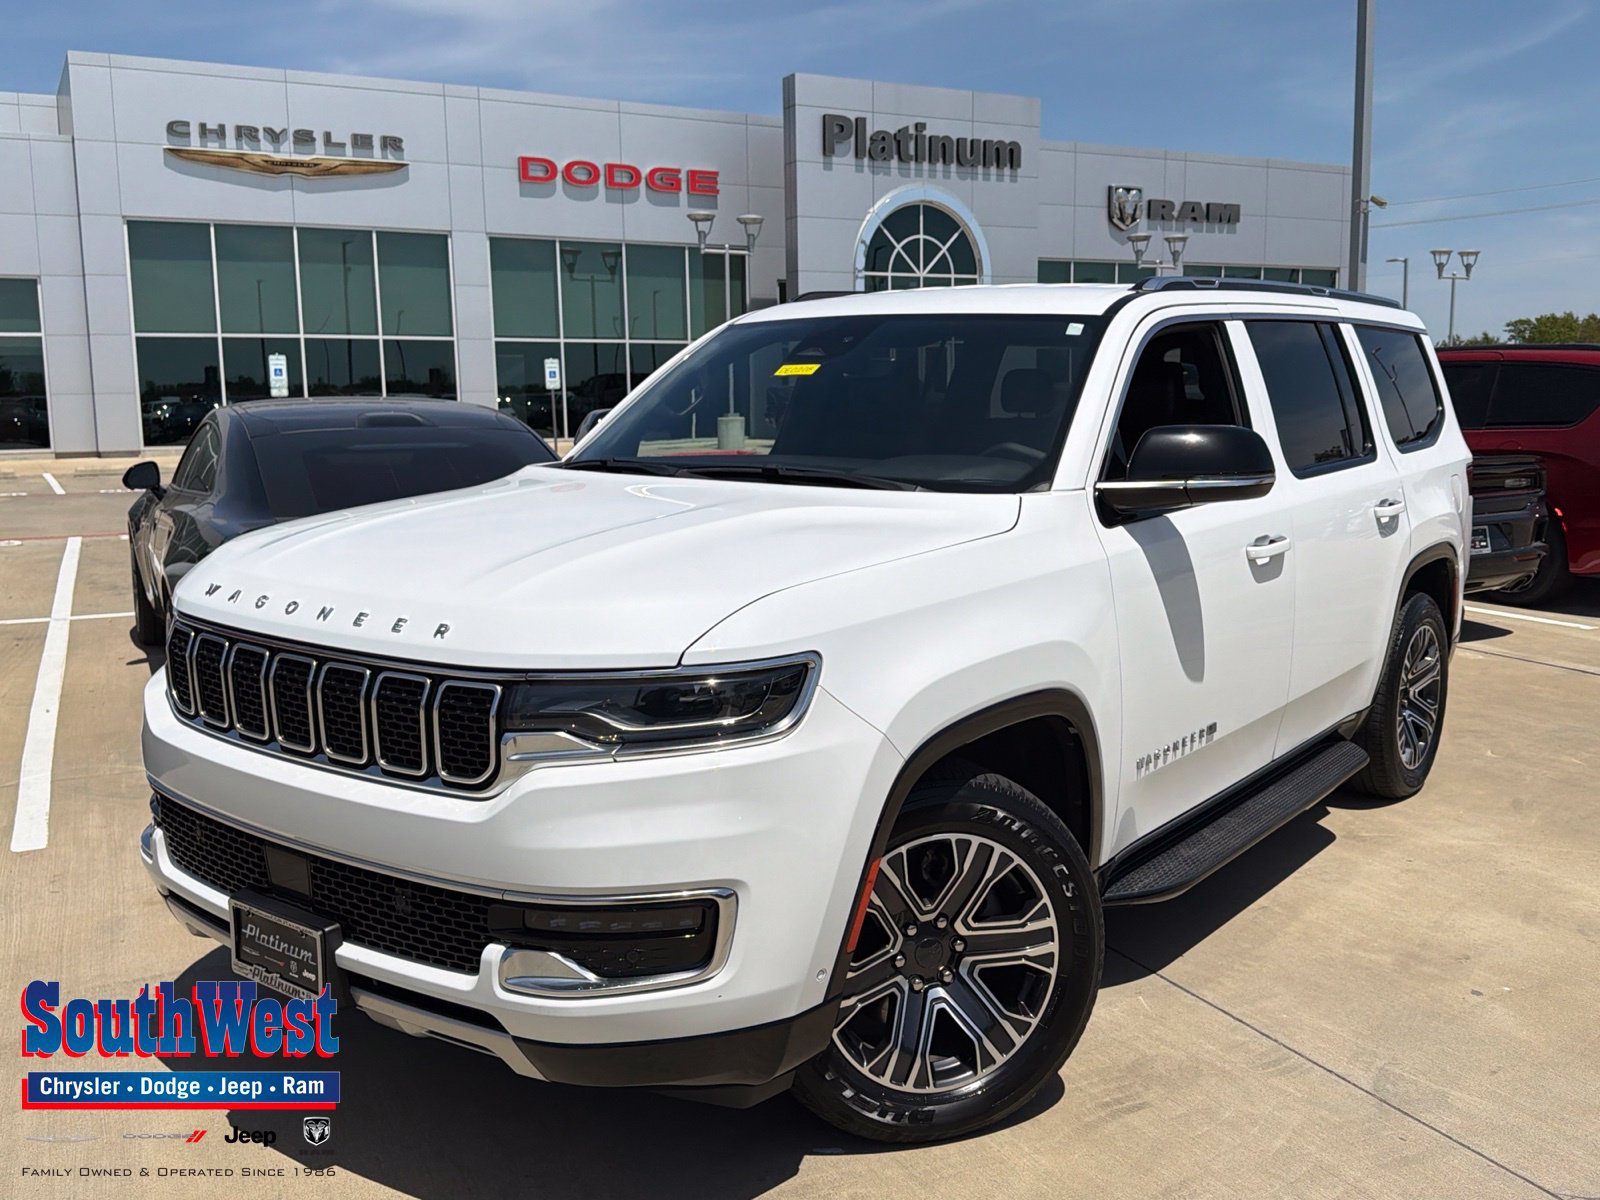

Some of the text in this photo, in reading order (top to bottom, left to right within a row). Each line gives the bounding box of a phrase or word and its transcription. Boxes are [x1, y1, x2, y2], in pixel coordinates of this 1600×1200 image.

[166, 119, 404, 151] CHRYSLER
[822, 113, 1022, 170] Platinum
[518, 156, 720, 195] DODGE
[1147, 199, 1241, 224] RAM
[204, 582, 451, 639] WAGONEER
[241, 923, 316, 966] Platinum
[251, 966, 302, 999] Platinum
